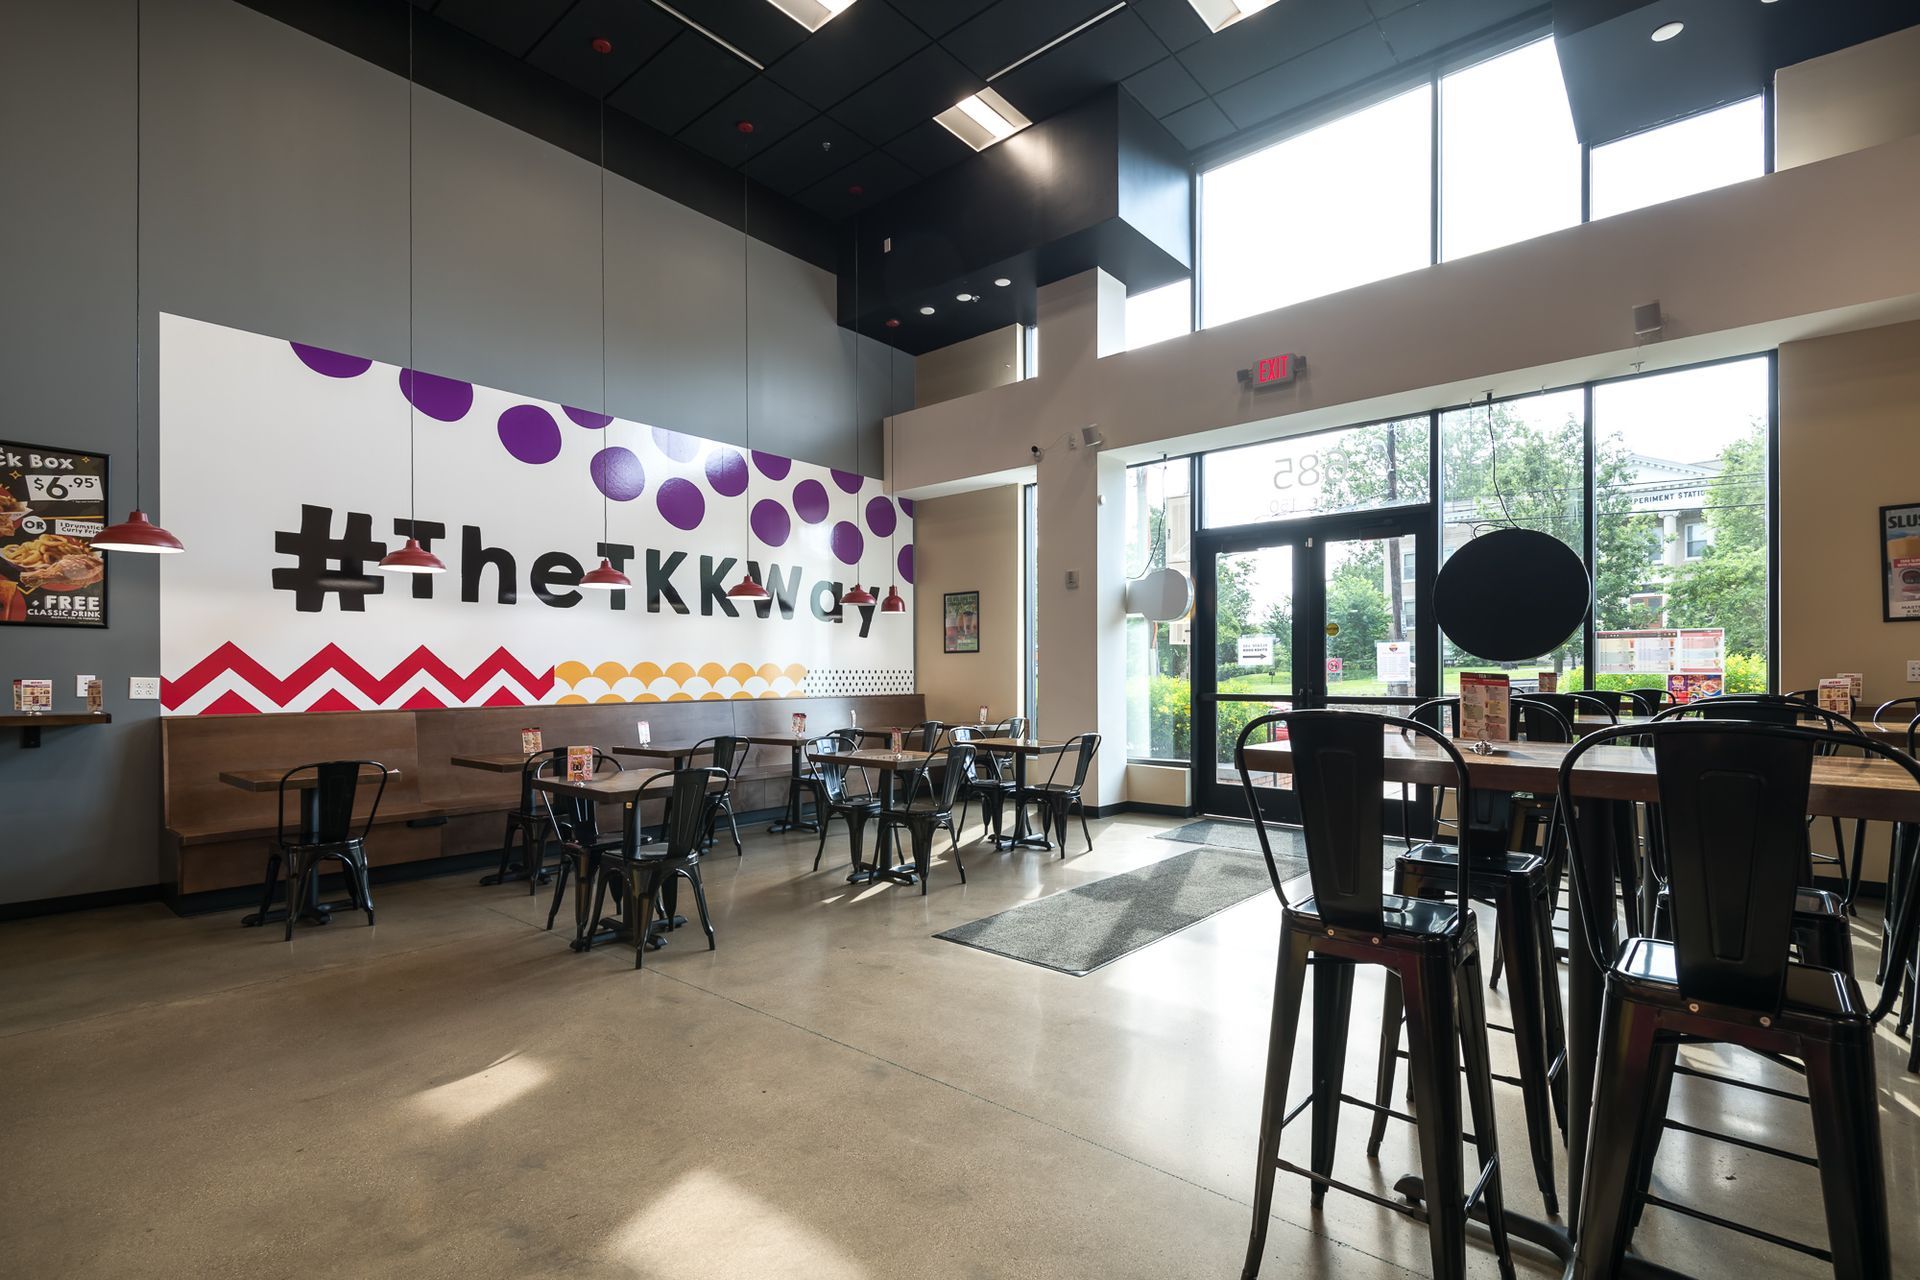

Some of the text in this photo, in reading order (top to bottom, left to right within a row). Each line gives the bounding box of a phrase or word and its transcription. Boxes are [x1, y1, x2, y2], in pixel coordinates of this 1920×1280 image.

[1260, 355, 1288, 382] EXIT
[1627, 490, 1706, 505] PERIMENT STATIO
[24, 520, 44, 530] OR
[1888, 514, 1920, 528] SLU
[272, 504, 880, 638] #TheTKKWay
[44, 595, 99, 610] FREE
